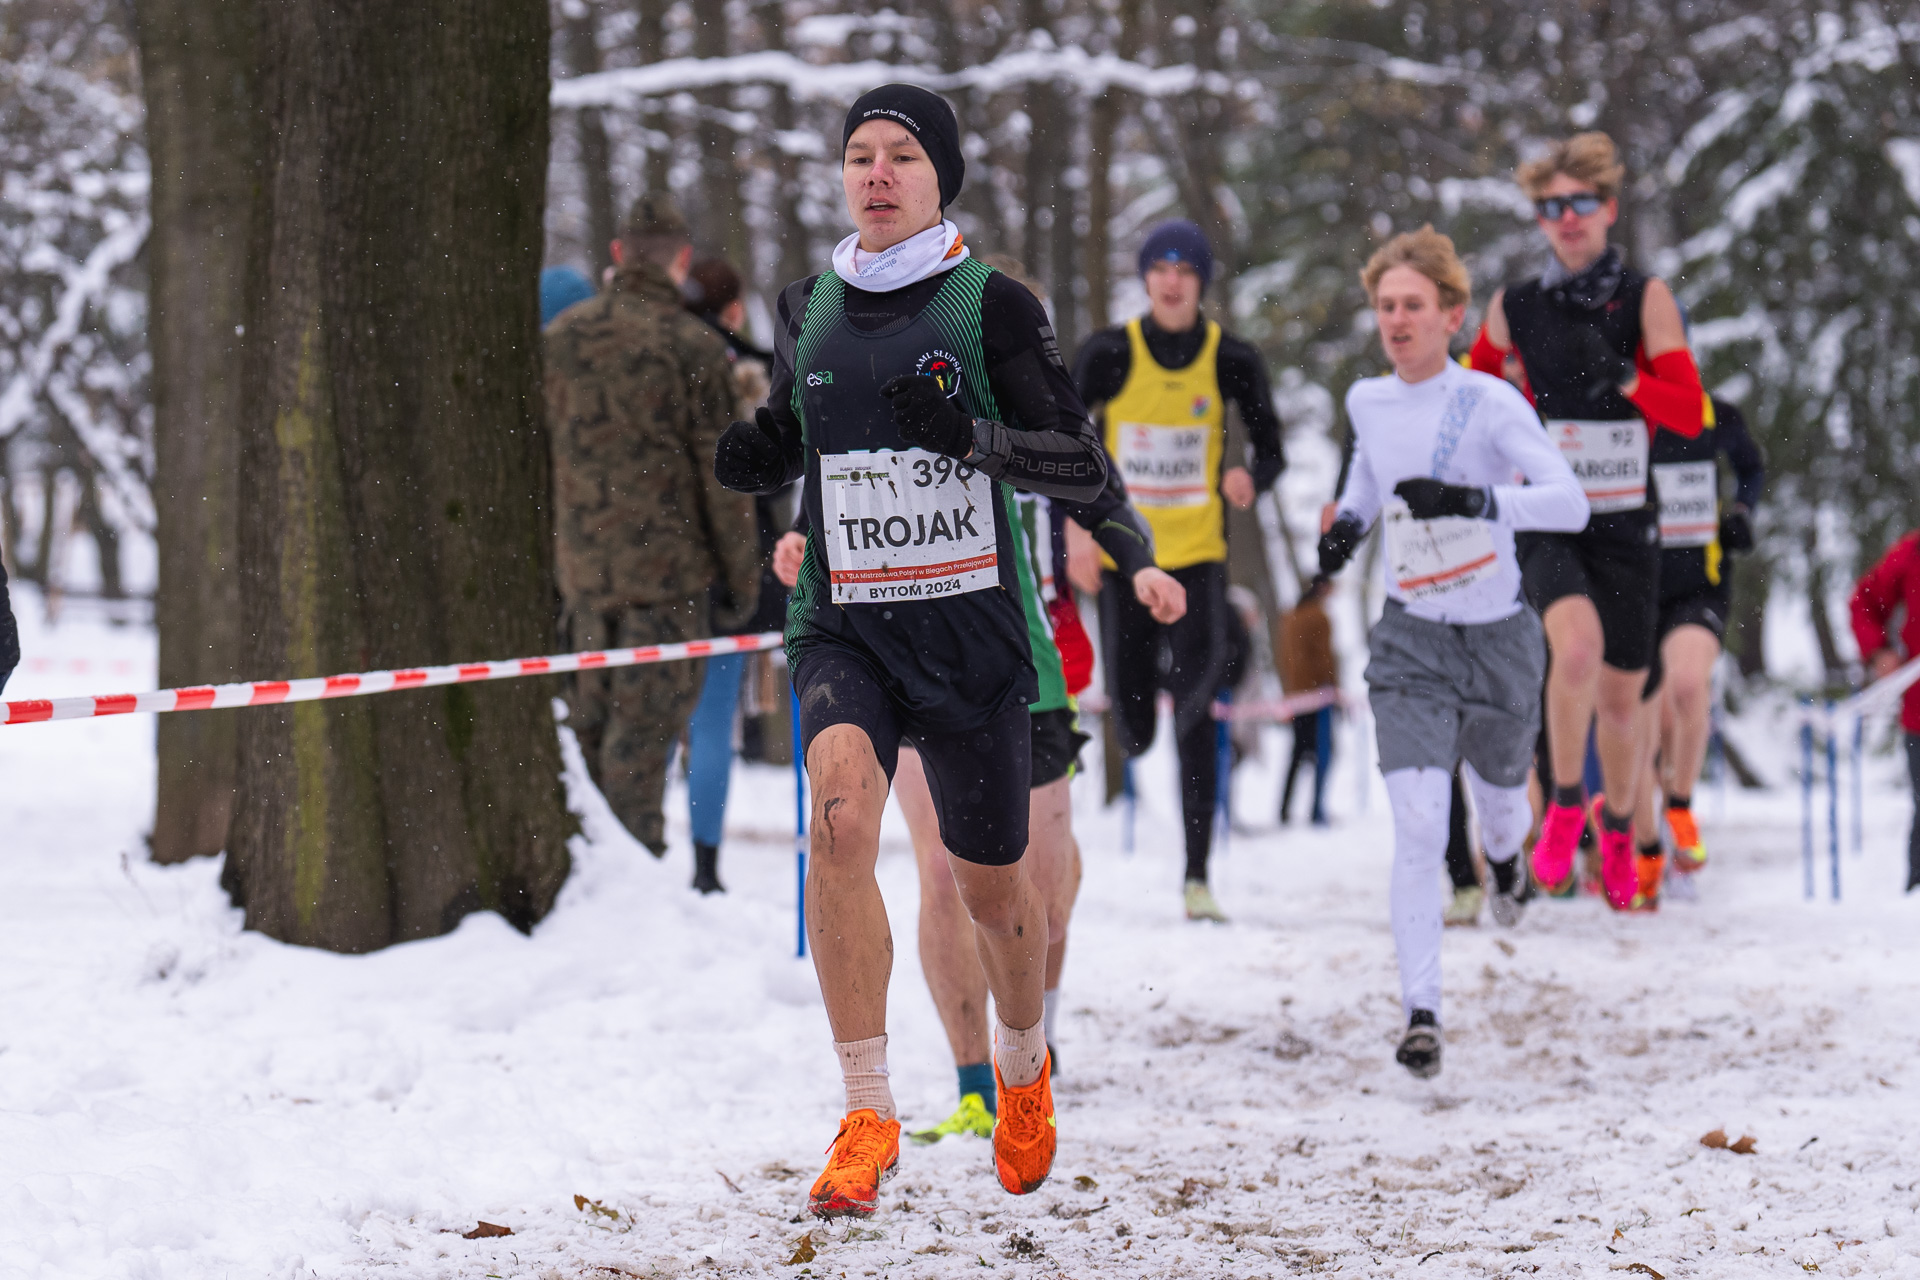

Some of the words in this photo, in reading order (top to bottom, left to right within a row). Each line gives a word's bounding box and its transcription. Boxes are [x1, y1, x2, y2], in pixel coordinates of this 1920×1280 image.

[915, 352, 933, 371] AML
[838, 505, 980, 551] TROJAK
[899, 568, 918, 576] Polski
[925, 565, 953, 575] Biegach
[869, 583, 922, 599] BYTOM
[925, 578, 962, 595] 2024
